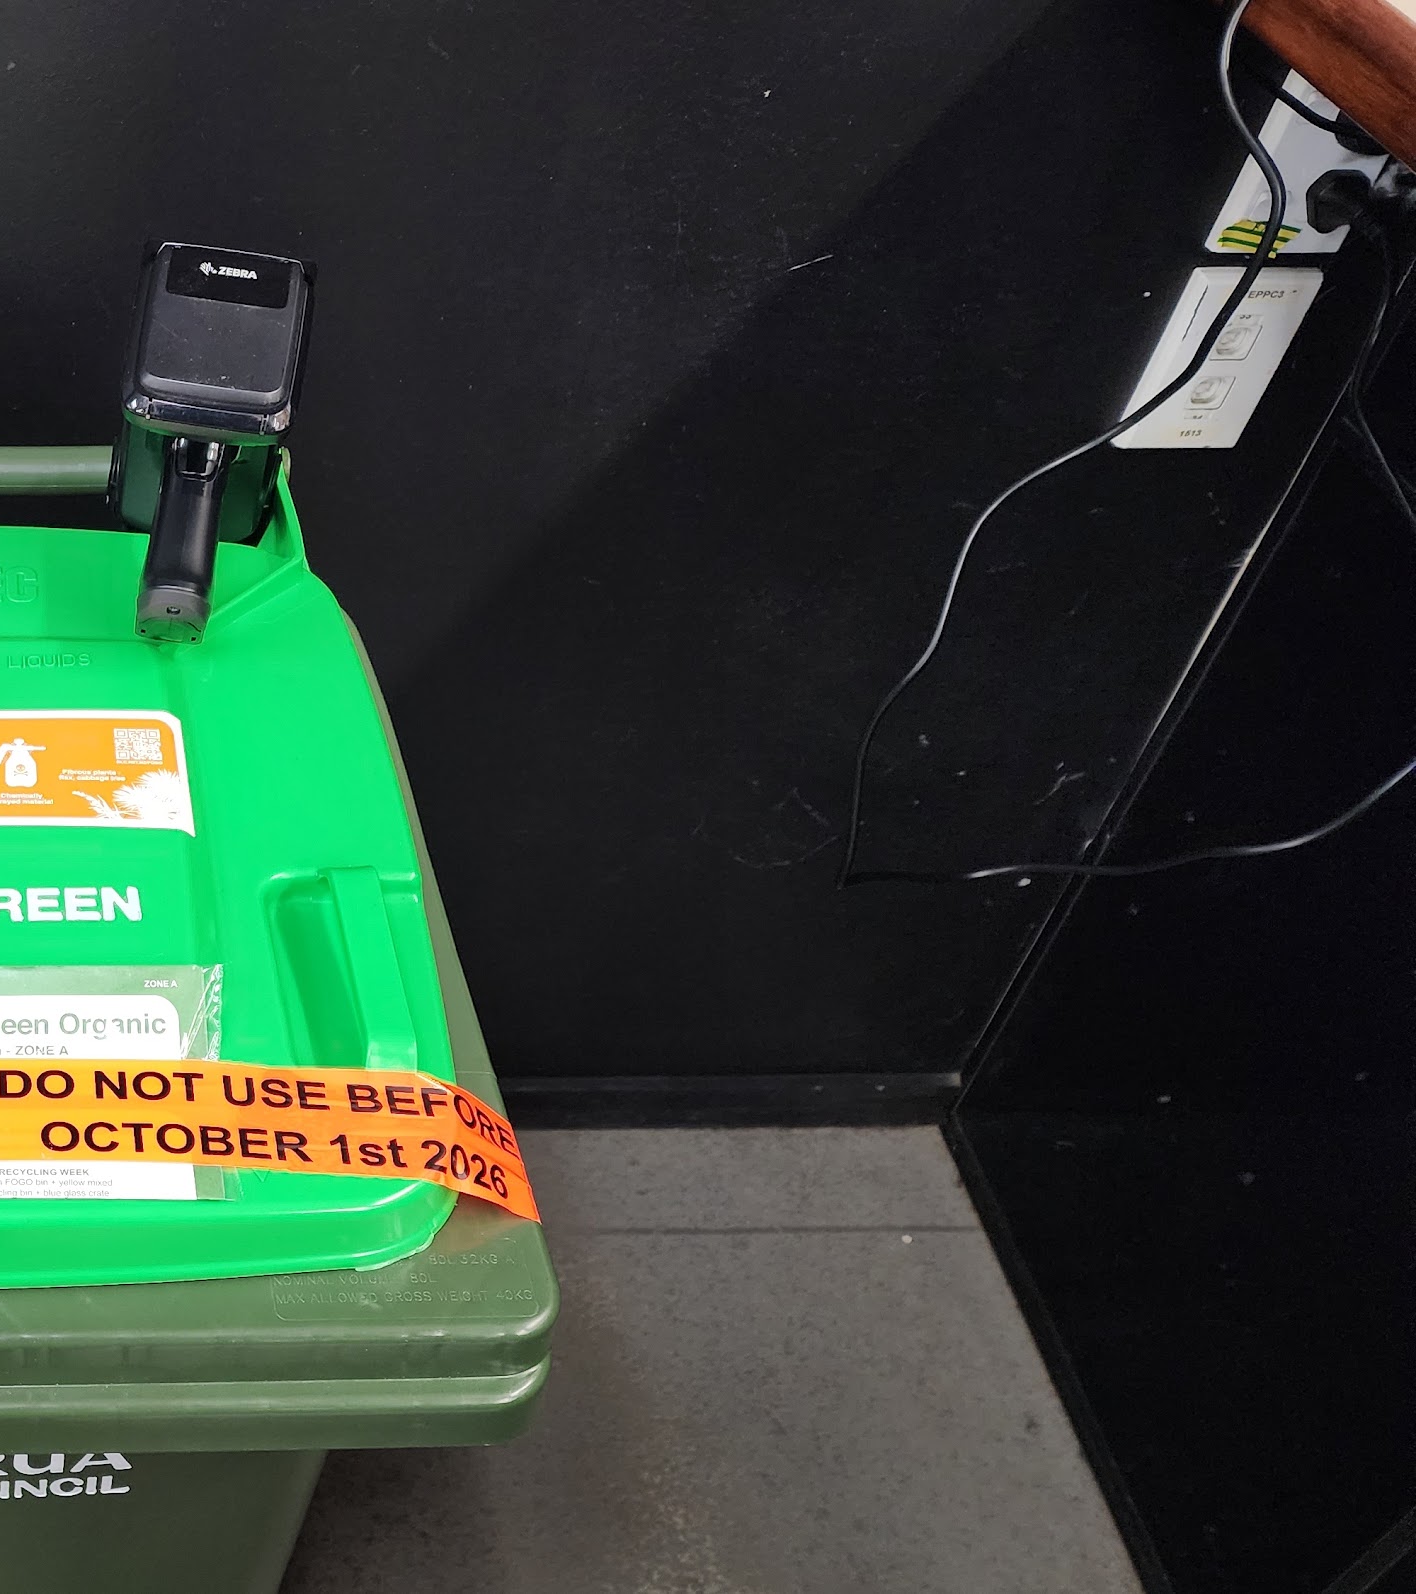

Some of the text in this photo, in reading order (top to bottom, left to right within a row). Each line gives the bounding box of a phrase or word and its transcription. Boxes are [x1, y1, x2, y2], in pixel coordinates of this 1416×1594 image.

[217, 266, 258, 280] ZEBRA
[7, 652, 92, 669] LIQUIDS
[144, 980, 169, 988] ZONE
[59, 1012, 166, 1040] Organic
[15, 1045, 55, 1056] ZONE
[59, 1045, 69, 1056] A
[94, 1070, 204, 1101] NOT
[224, 1077, 328, 1110] USE
[347, 1084, 521, 1160] BEFORE
[40, 1121, 508, 1199] OCTOBER 1st 2026
[0, 1168, 89, 1176] RECYCLING WEEK
[5, 1178, 33, 1186] FOGO
[36, 1178, 48, 1186] bin
[59, 1178, 85, 1187] yellow
[87, 1179, 113, 1187] mixed
[20, 1189, 33, 1197] bin
[43, 1189, 63, 1197] blue
[65, 1190, 87, 1199] glass
[273, 1275, 333, 1287] NOMINAL
[275, 1289, 533, 1304] MAX ALLOWED GROSS WEIGHT 40KG
